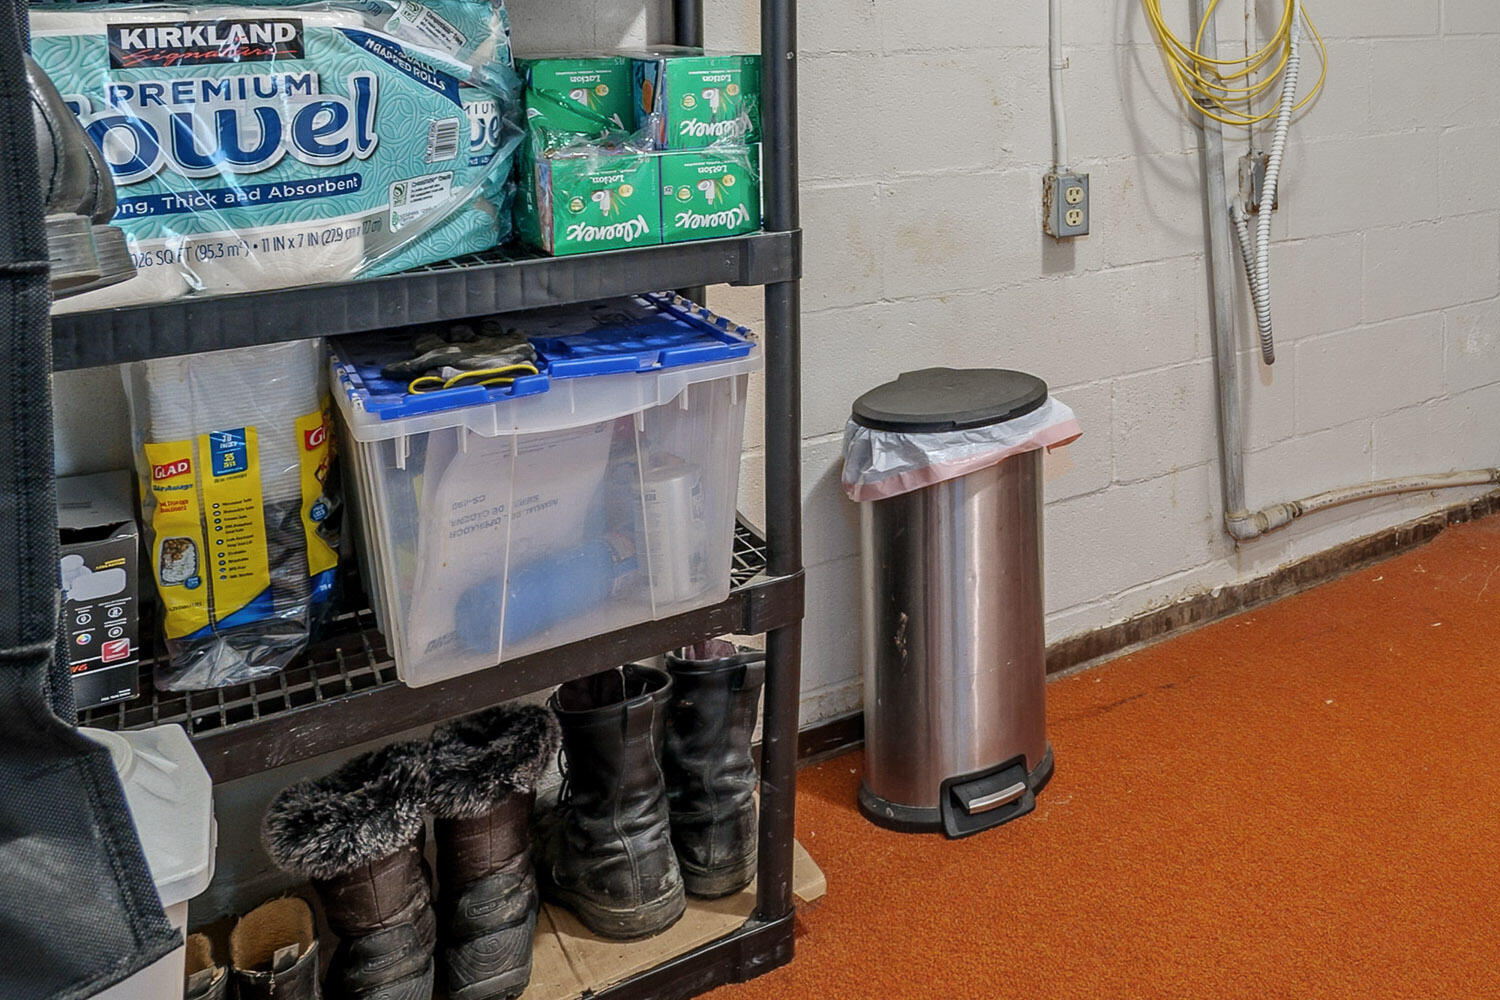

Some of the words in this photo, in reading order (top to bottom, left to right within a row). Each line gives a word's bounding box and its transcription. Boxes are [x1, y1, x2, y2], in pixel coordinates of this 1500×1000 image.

[119, 22, 297, 50] KIRKLAND
[121, 45, 297, 67] Signature
[108, 73, 313, 109] PREMIUM
[413, 66, 446, 92] ROLLS
[569, 74, 601, 84] Lotion
[702, 73, 733, 83] Lotion
[80, 76, 373, 177] owel
[680, 110, 753, 139] Kleenex
[590, 173, 625, 184] Lotion
[697, 164, 728, 174] Lotion
[113, 197, 155, 218] ong,
[161, 191, 217, 210] Thick
[224, 188, 261, 204] and
[267, 176, 359, 199] Absorbent
[566, 214, 650, 243] Kleenex
[674, 202, 751, 230] Kleenex
[156, 249, 174, 266] SQ
[178, 246, 193, 263] FT
[194, 242, 224, 261] (95.3
[261, 238, 271, 252] 11
[273, 236, 285, 250] IN
[287, 238, 295, 249] x
[296, 233, 304, 247] 7
[307, 232, 319, 247] IN
[153, 461, 189, 480] GLAD
